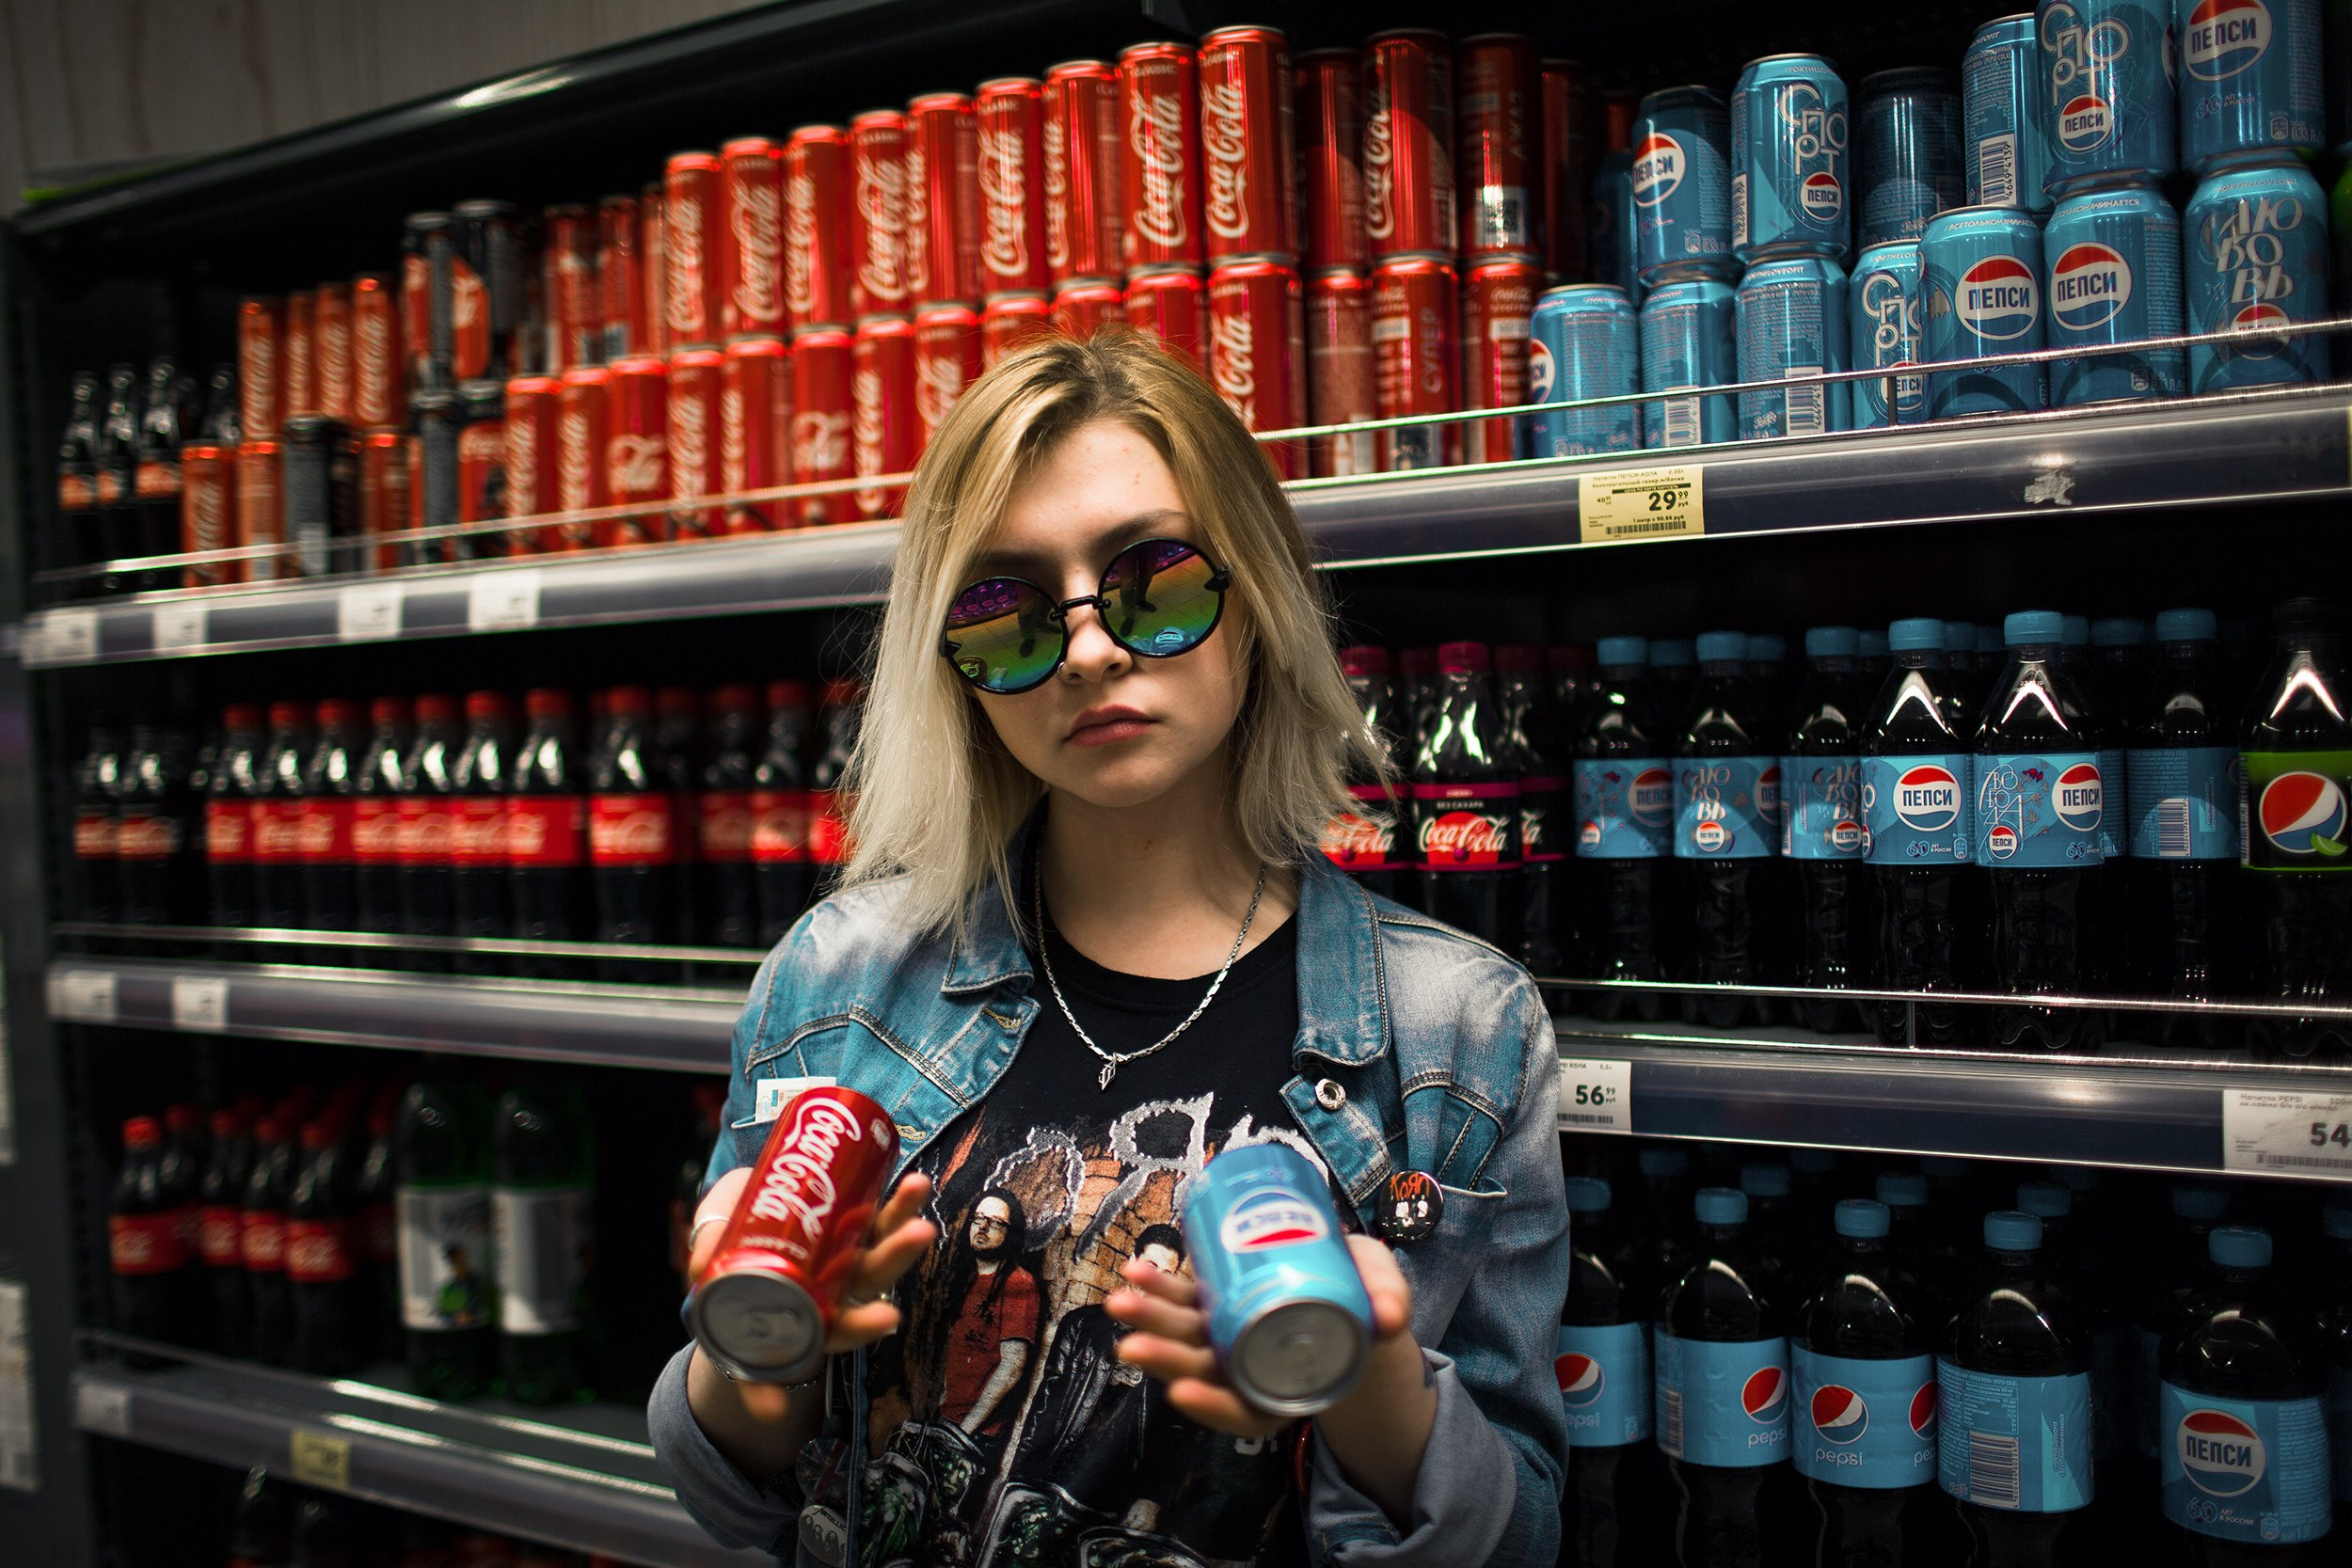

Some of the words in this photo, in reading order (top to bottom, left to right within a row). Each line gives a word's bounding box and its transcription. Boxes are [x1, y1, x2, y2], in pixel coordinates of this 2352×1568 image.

[2192, 17, 2257, 55] ПЕПСИ
[2065, 112, 2105, 134] ПЕПСИ
[1807, 189, 1838, 203] ПЕПСИ
[2057, 271, 2117, 303] ПЕПСИ
[1969, 287, 2030, 310] ПЕПСИ
[1648, 490, 1677, 511] 29
[1678, 491, 1689, 499] 99
[1903, 789, 1952, 806] ПЕПСИ
[2062, 788, 2100, 806] ПЕПСИ
[1420, 815, 1510, 853] Coca-Cola
[1992, 837, 2012, 847] ПЕПСИ
[1575, 1085, 1605, 1106] 56
[2311, 1122, 2352, 1148] 54
[750, 1097, 863, 1244] Coca-Cola
[1816, 1449, 1864, 1467] pepsi
[2186, 1435, 2251, 1467] ПЕПСИ
[811, 1508, 847, 1531] METALLIC
